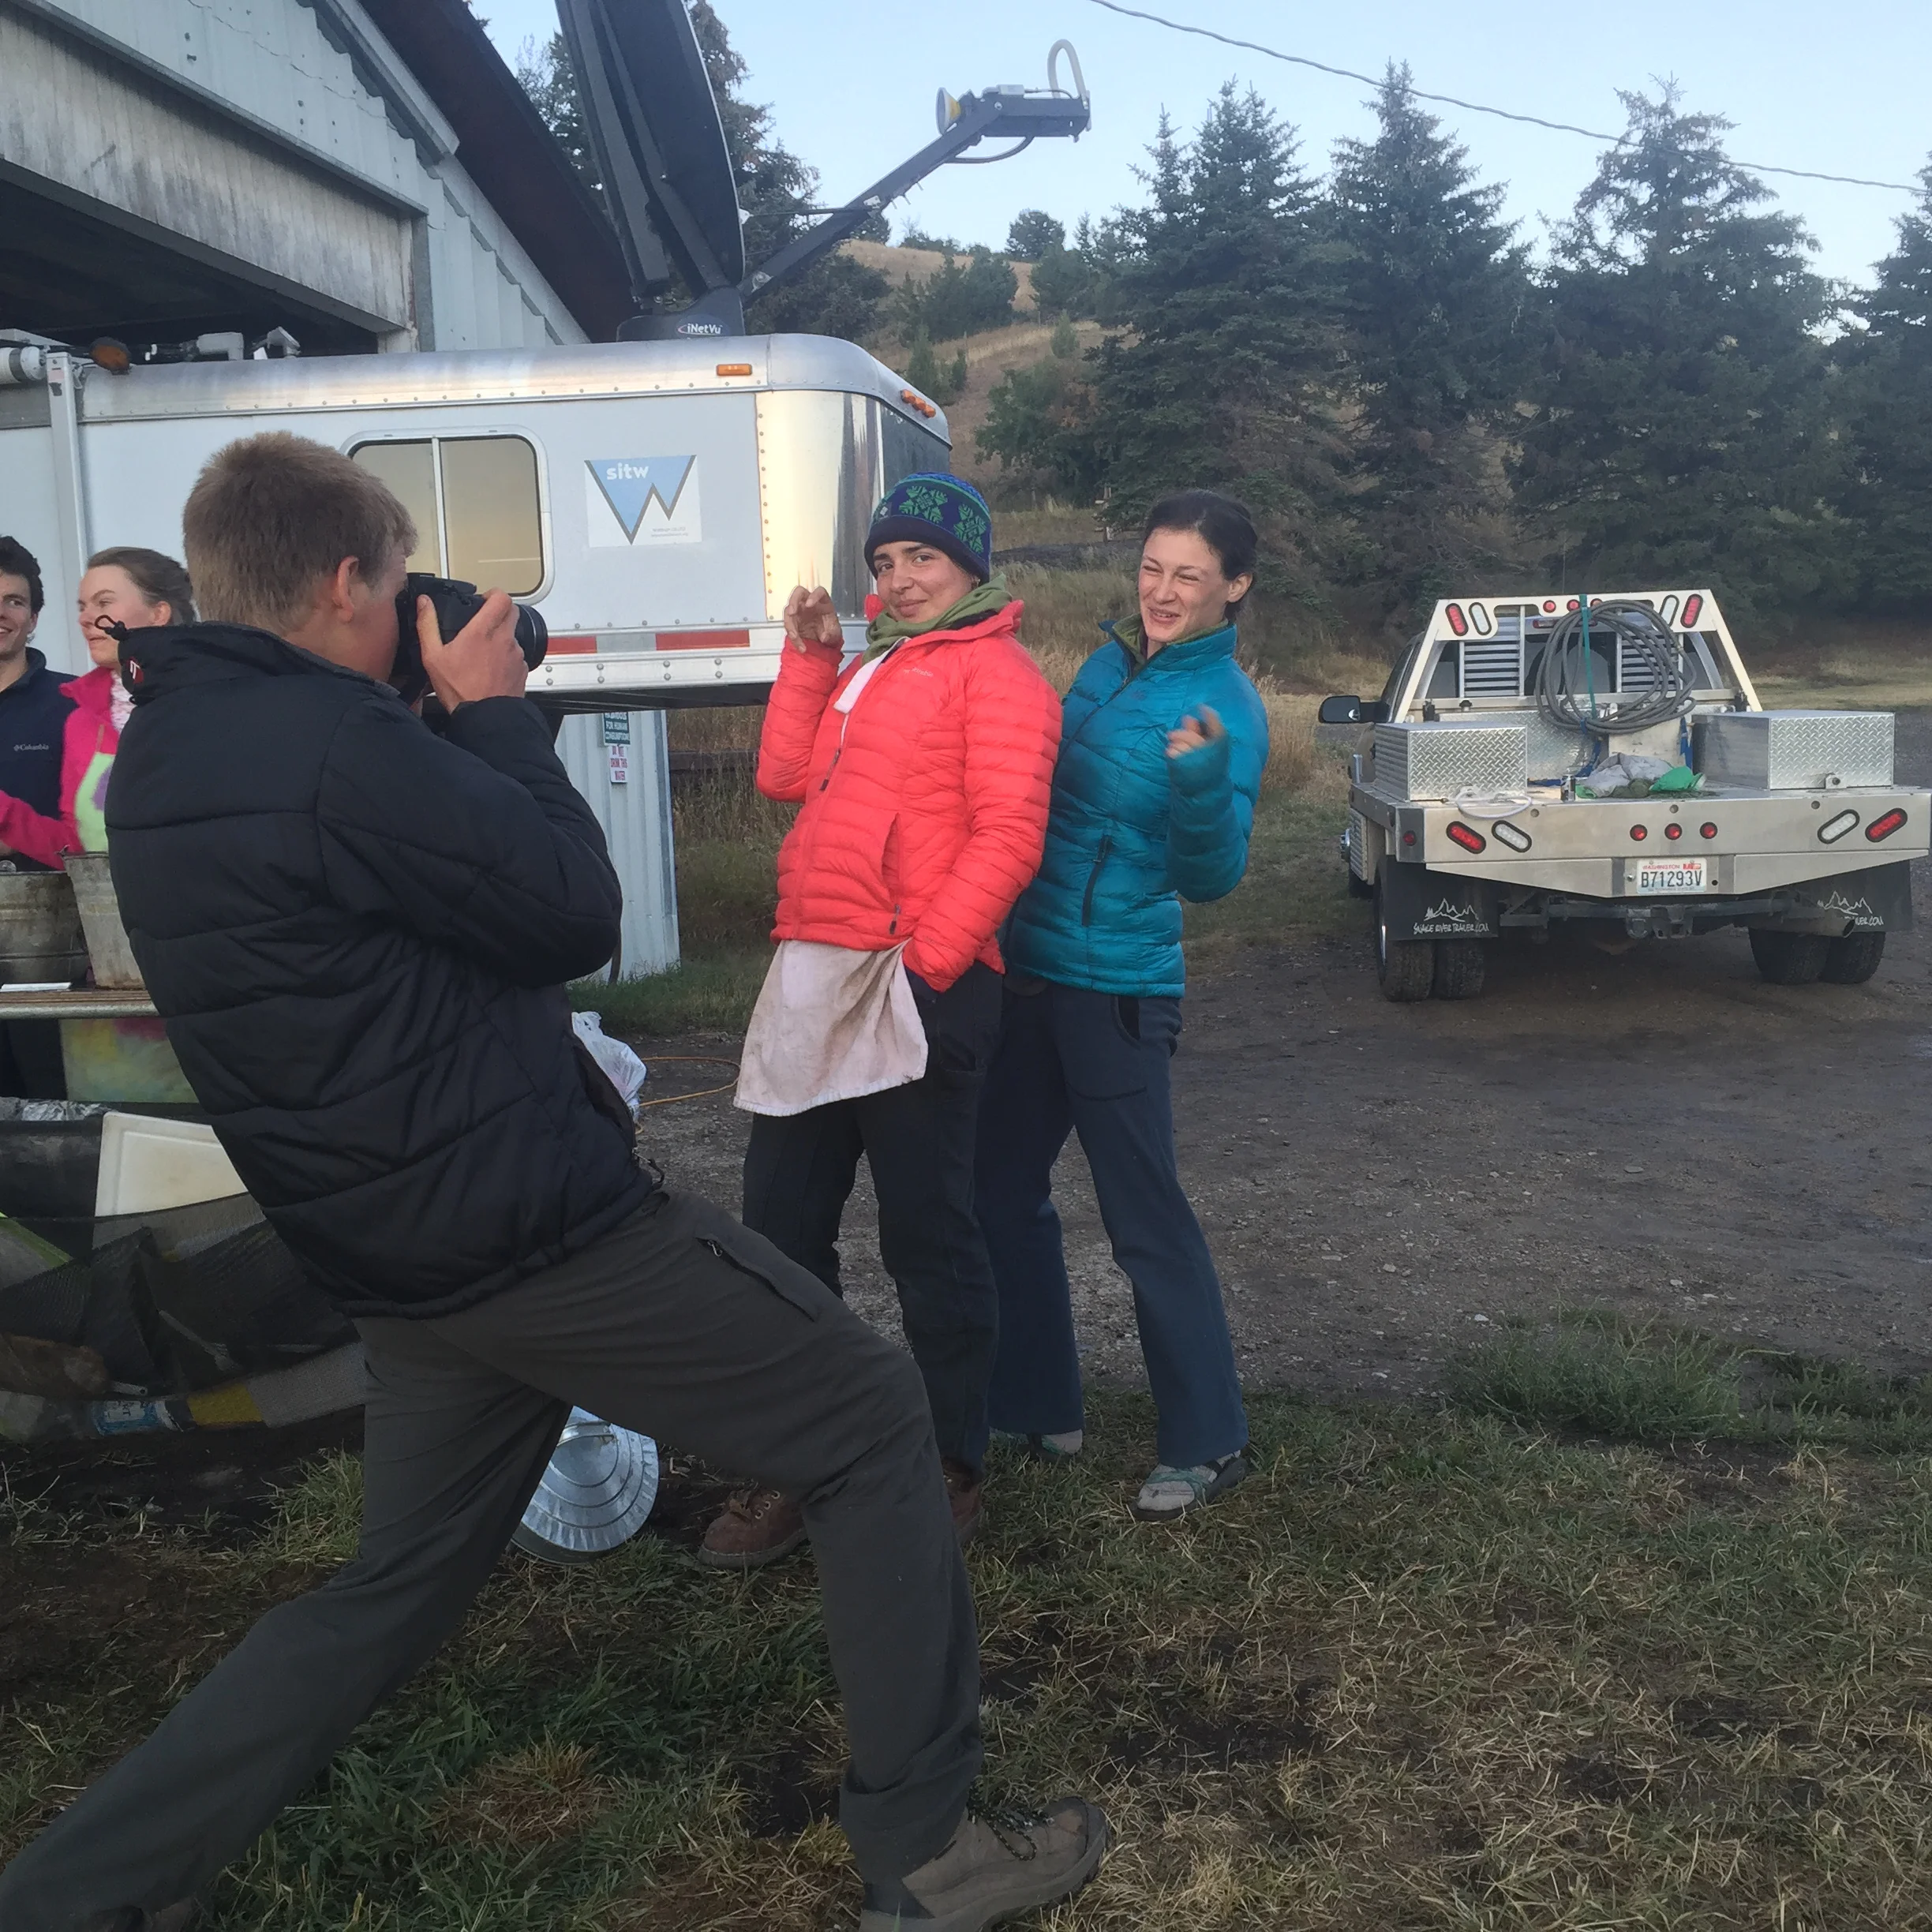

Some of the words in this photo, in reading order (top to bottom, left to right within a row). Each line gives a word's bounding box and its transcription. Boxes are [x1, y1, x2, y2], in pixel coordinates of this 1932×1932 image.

[687, 323, 721, 335] iNetVu
[606, 462, 649, 480] sitw
[1641, 870, 1702, 888] B71293V
